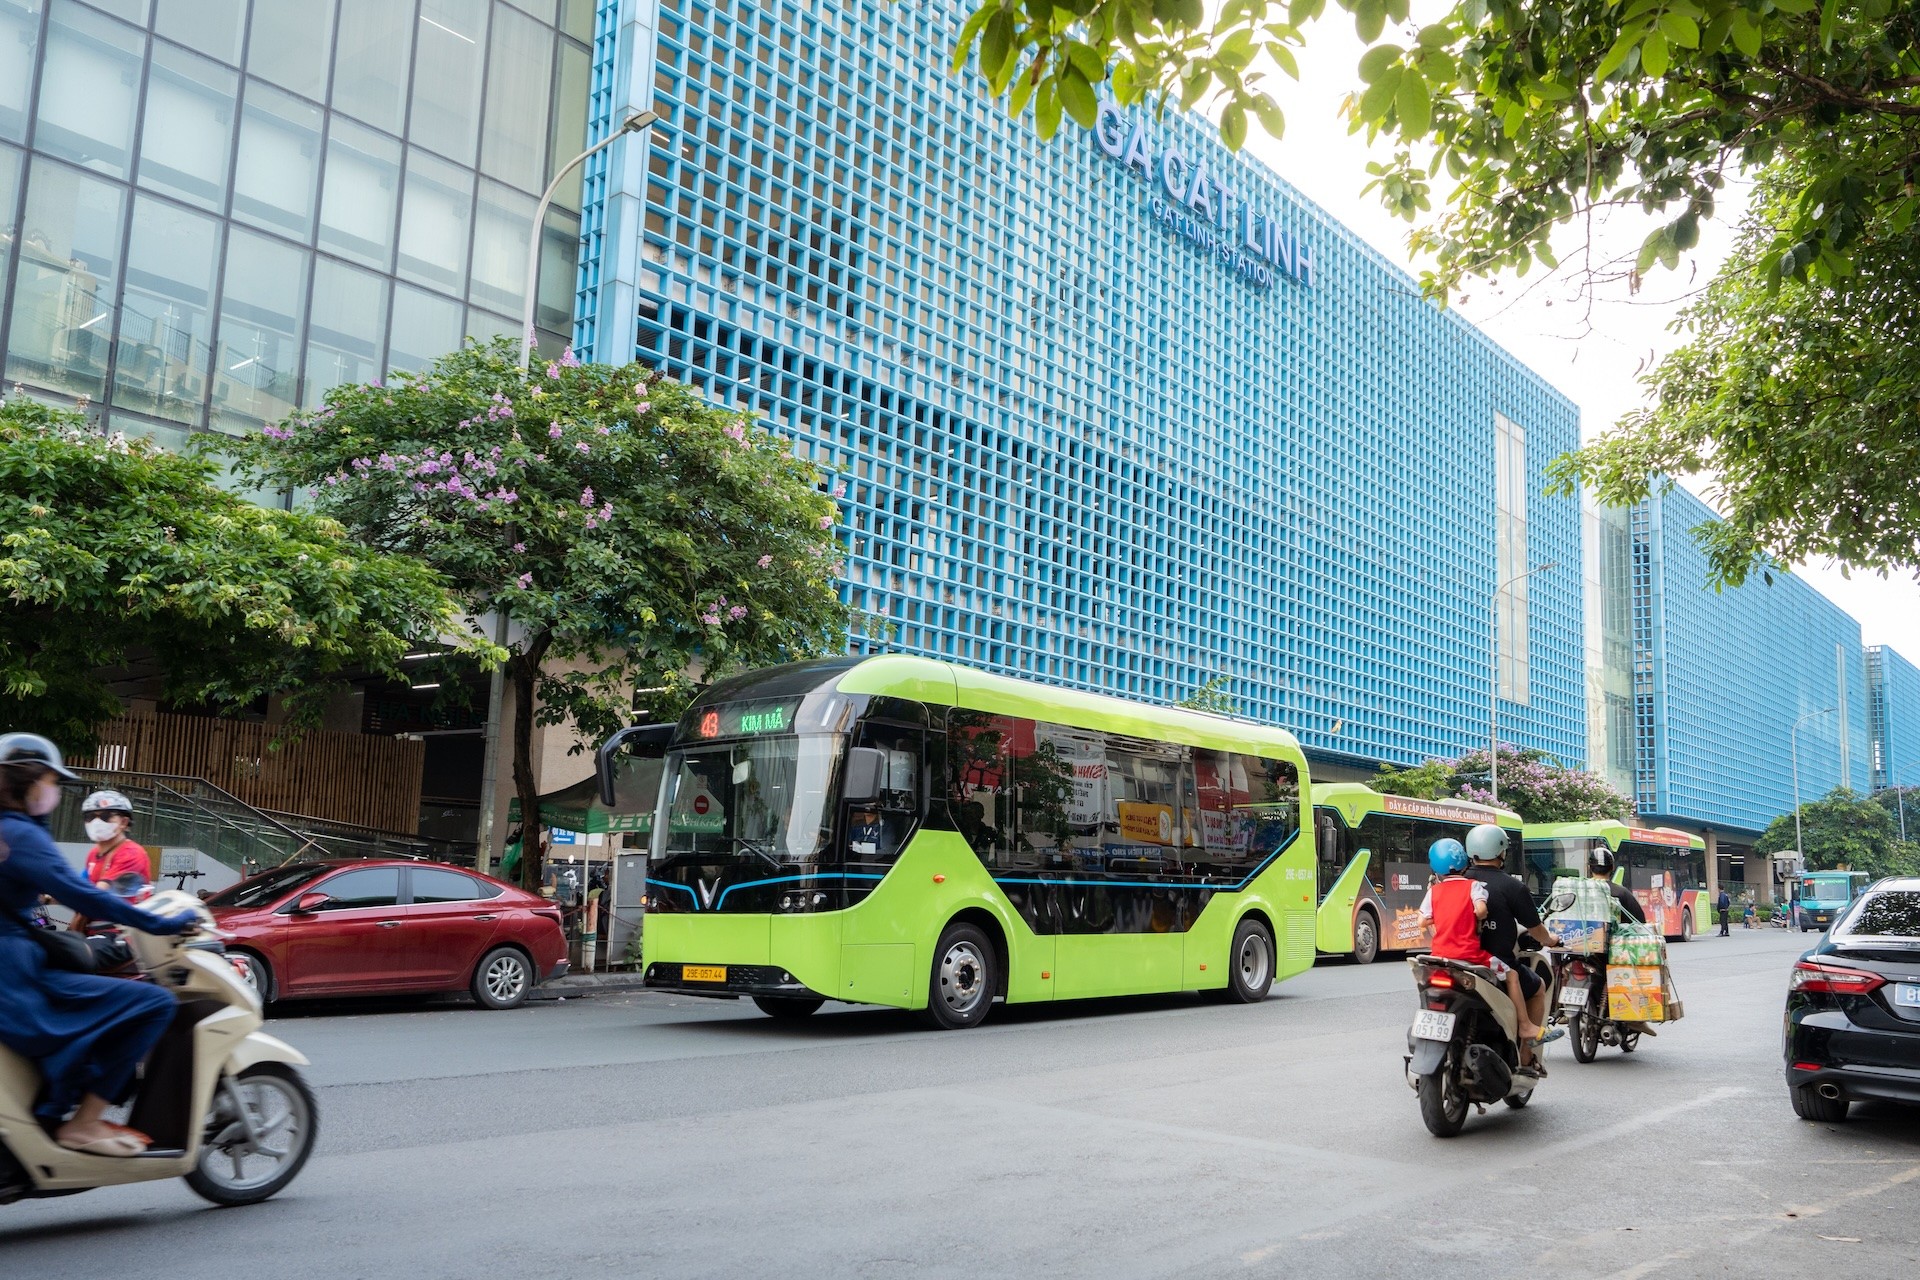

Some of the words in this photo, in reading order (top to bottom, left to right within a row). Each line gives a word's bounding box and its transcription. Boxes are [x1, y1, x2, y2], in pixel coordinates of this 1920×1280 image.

[1093, 100, 1152, 183] GA
[1241, 200, 1313, 288] LINH
[1149, 198, 1184, 232] CAT
[1185, 218, 1216, 250] LINH
[1220, 243, 1273, 288] STATION
[702, 712, 718, 737] 43
[741, 714, 762, 731] KIM
[765, 707, 784, 729] MÃ
[1389, 799, 1401, 810] DÂY
[1402, 803, 1408, 811] &
[1408, 803, 1420, 812] CÁP
[1420, 804, 1434, 816] ĐIỆN
[1435, 805, 1447, 816] HÀN
[1447, 807, 1463, 820] QUỐC
[1463, 810, 1480, 821] CHÍNH
[1399, 875, 1409, 884] KBI
[686, 968, 723, 979] 29E-057.44
[1415, 1024, 1450, 1039] 051.99
